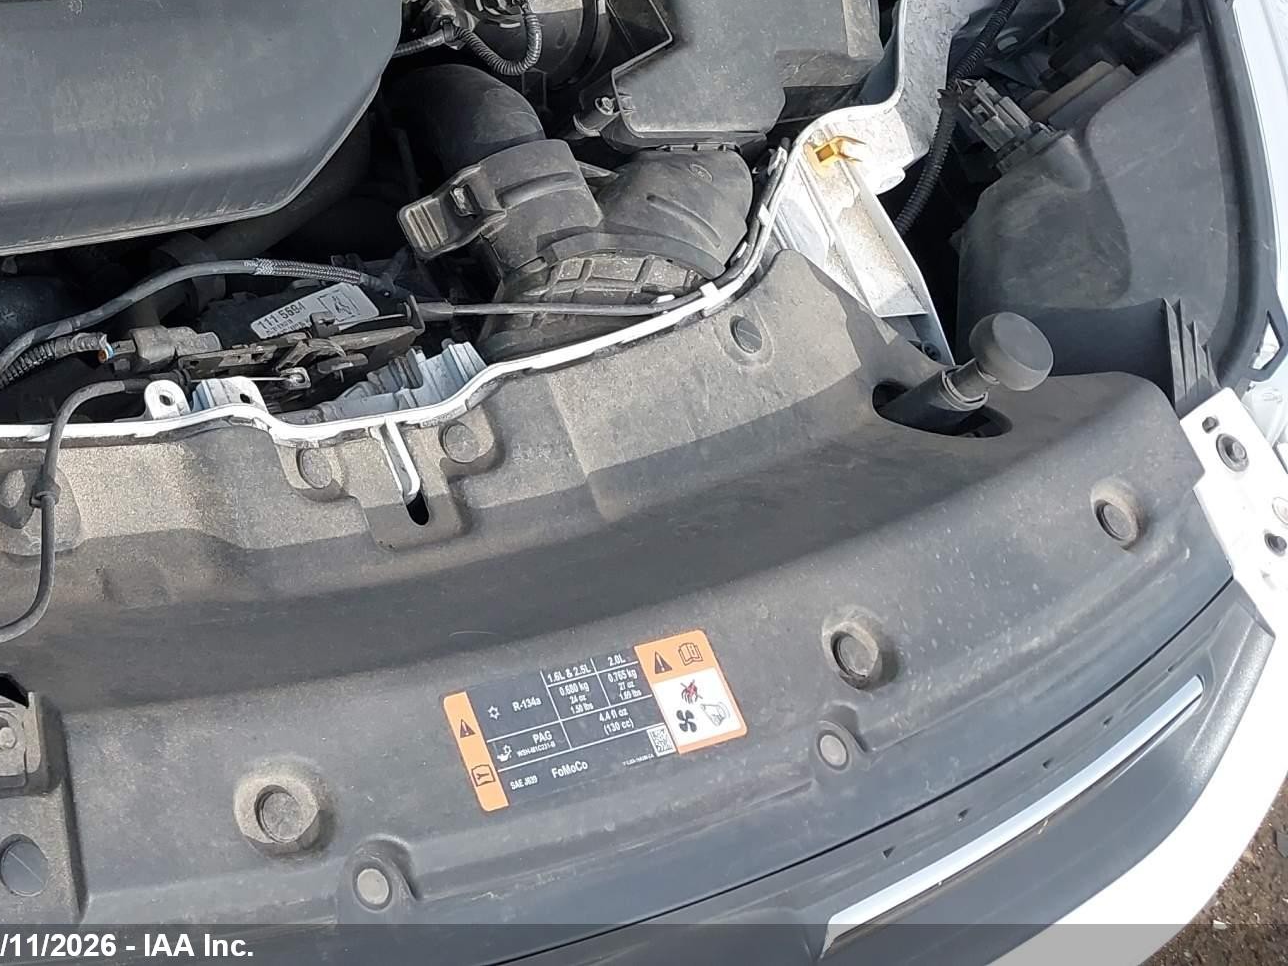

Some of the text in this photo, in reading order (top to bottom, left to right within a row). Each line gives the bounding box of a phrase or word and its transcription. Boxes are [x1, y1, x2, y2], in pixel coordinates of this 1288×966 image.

[608, 654, 626, 666] 2.0L
[548, 664, 591, 683] 1.6L & 2.5L
[627, 668, 637, 680] kg
[578, 682, 590, 692] kg
[512, 696, 542, 712] R-134a
[599, 710, 612, 722] 4.4
[618, 708, 628, 718] oz
[621, 718, 634, 729] cc)
[532, 730, 553, 744] PAG
[551, 760, 589, 778] FoMoCo
[510, 778, 524, 790] SAE
